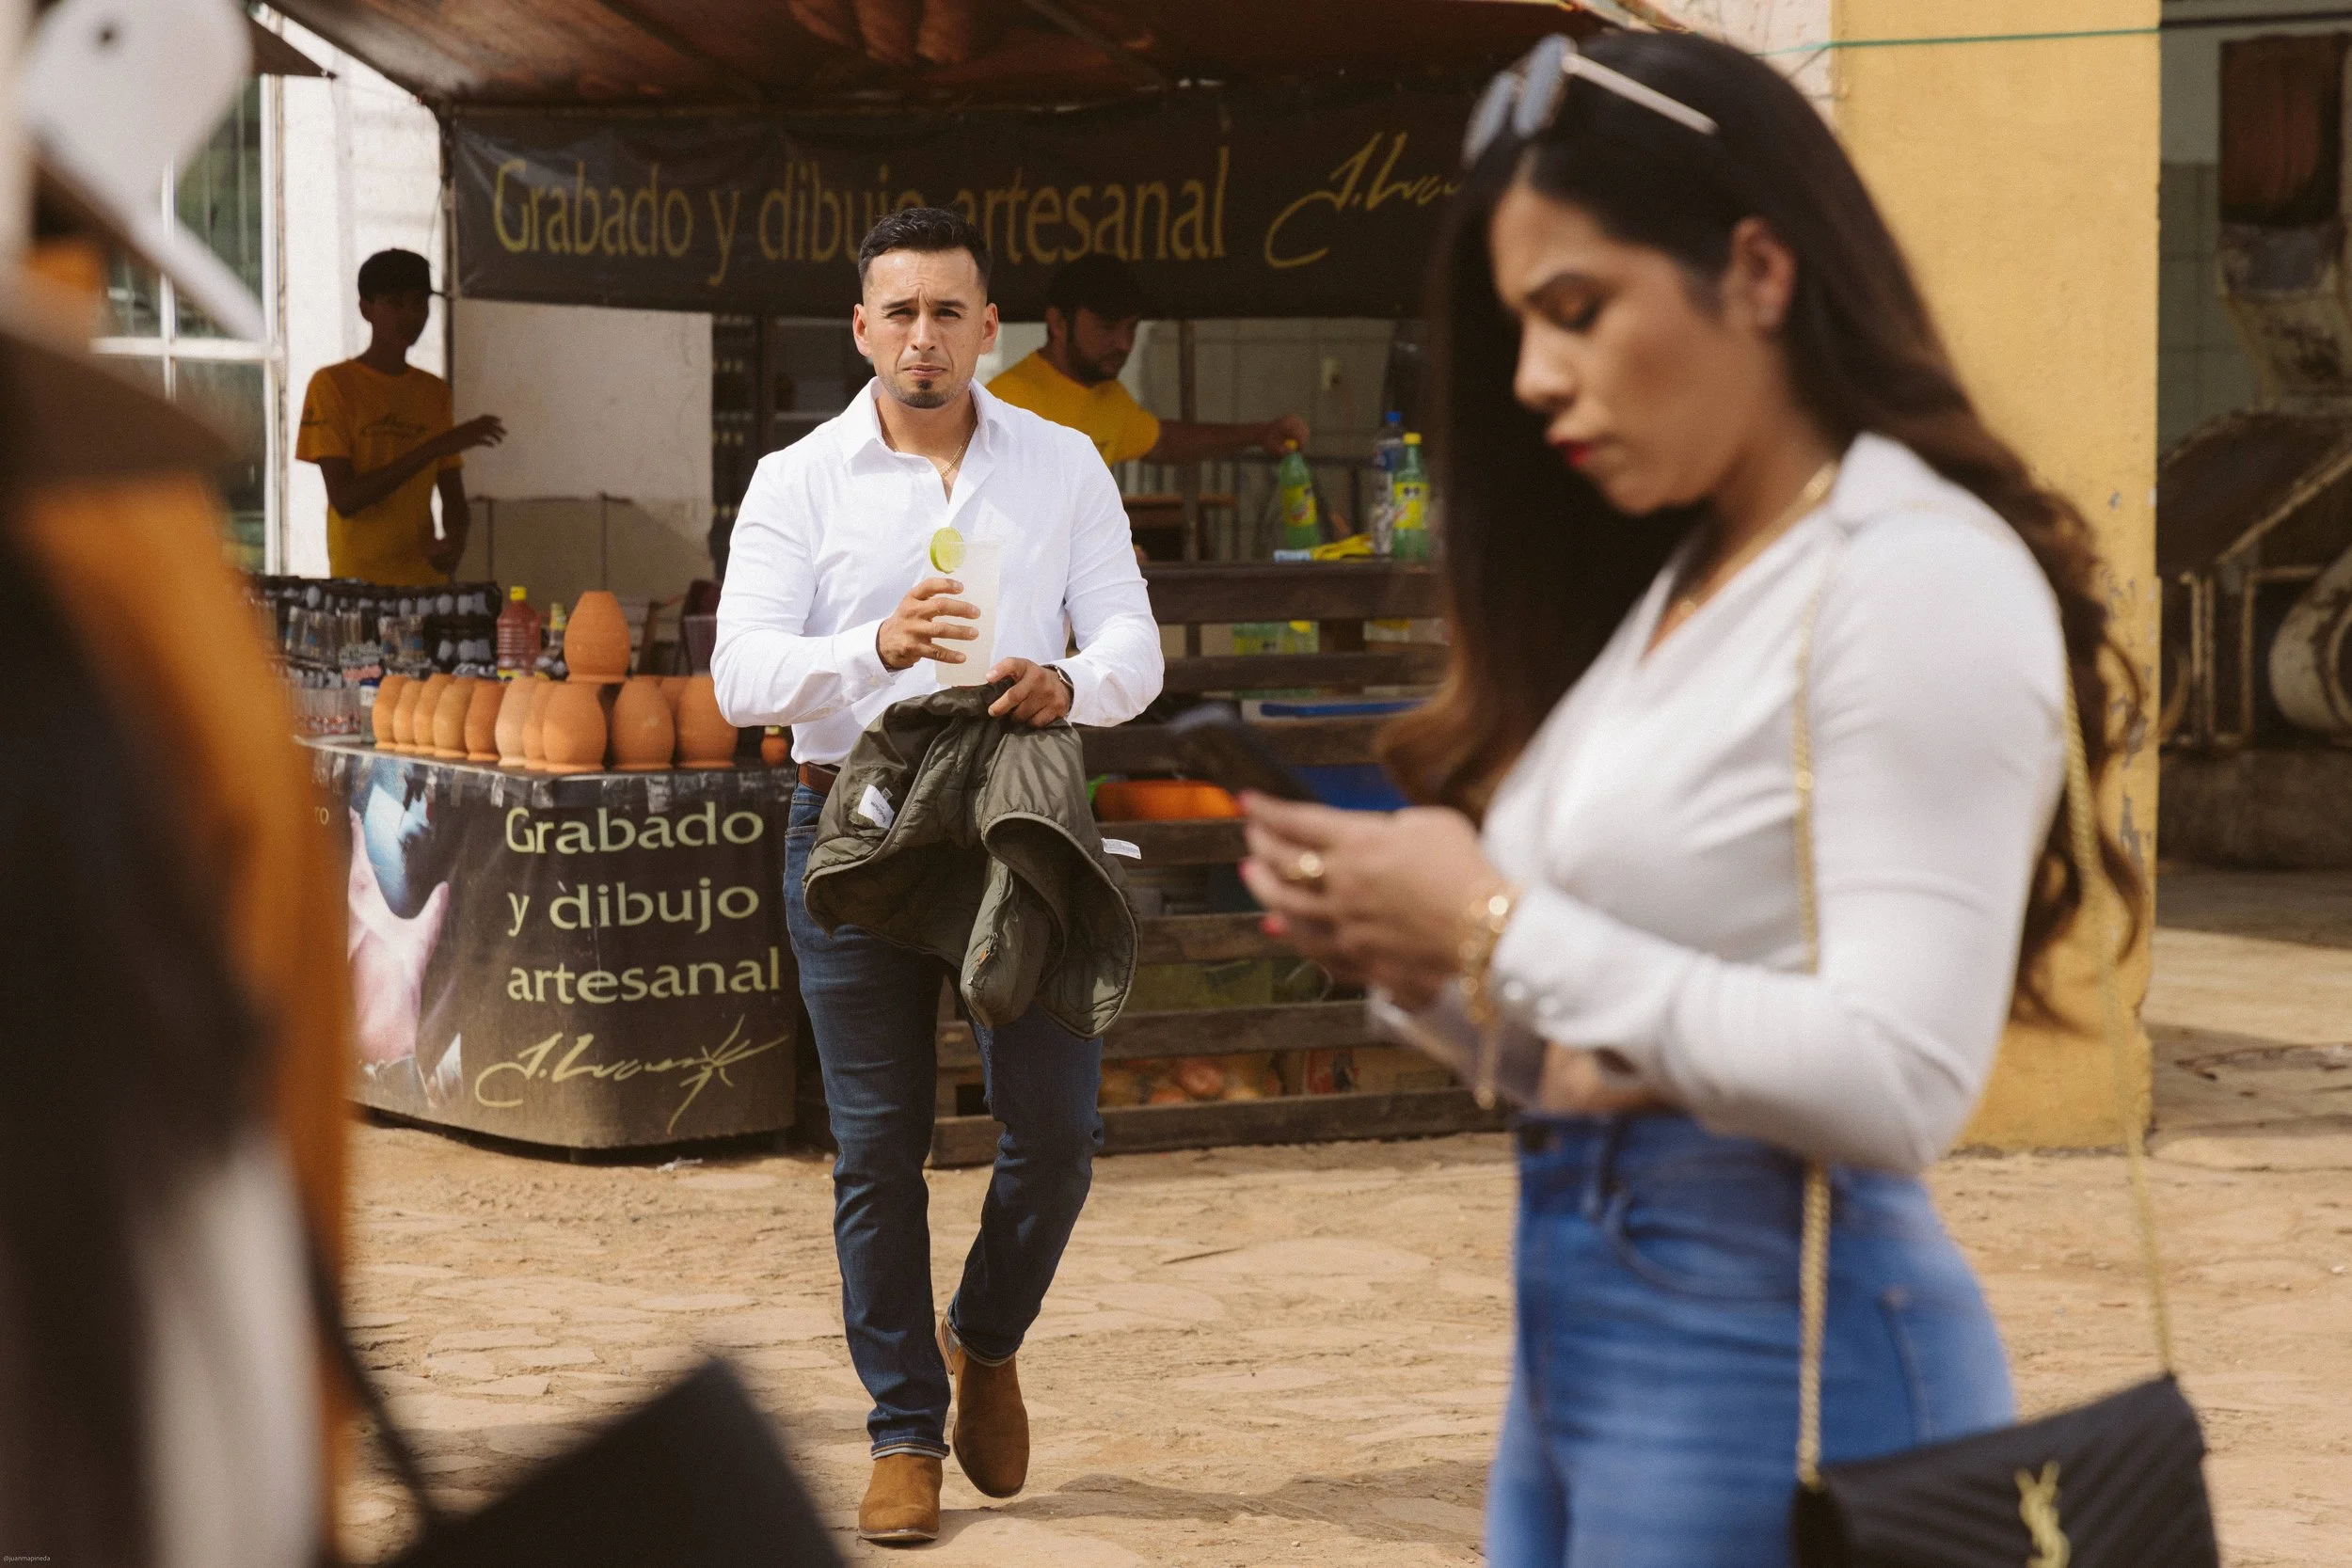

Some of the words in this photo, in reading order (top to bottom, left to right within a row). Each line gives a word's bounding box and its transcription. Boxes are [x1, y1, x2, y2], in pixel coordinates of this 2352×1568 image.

[493, 158, 693, 258] Grabado
[708, 187, 740, 286] y
[758, 161, 927, 262] dibu
[505, 801, 764, 854] Grabado
[507, 892, 531, 937] y
[548, 877, 759, 934] dibujo
[507, 946, 780, 1005] artesanal
